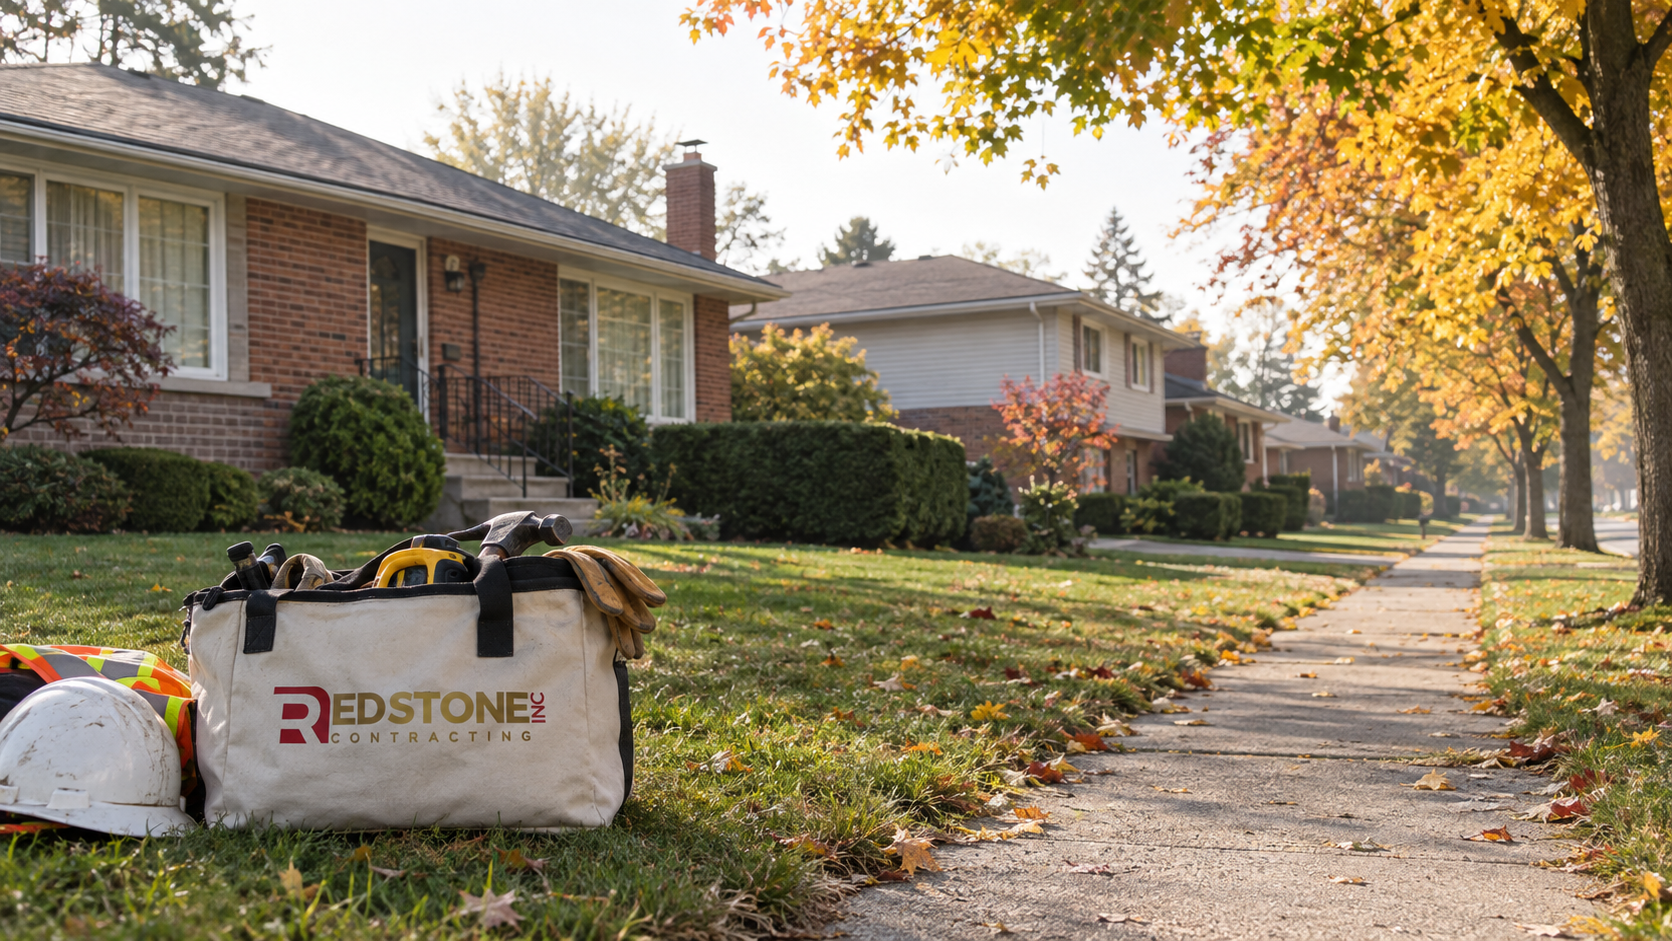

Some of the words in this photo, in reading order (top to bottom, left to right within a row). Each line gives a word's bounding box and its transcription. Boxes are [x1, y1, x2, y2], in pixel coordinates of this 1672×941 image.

[273, 686, 530, 744] REDSTONE
[530, 692, 546, 723] INC
[330, 731, 532, 744] CONTRACTING
